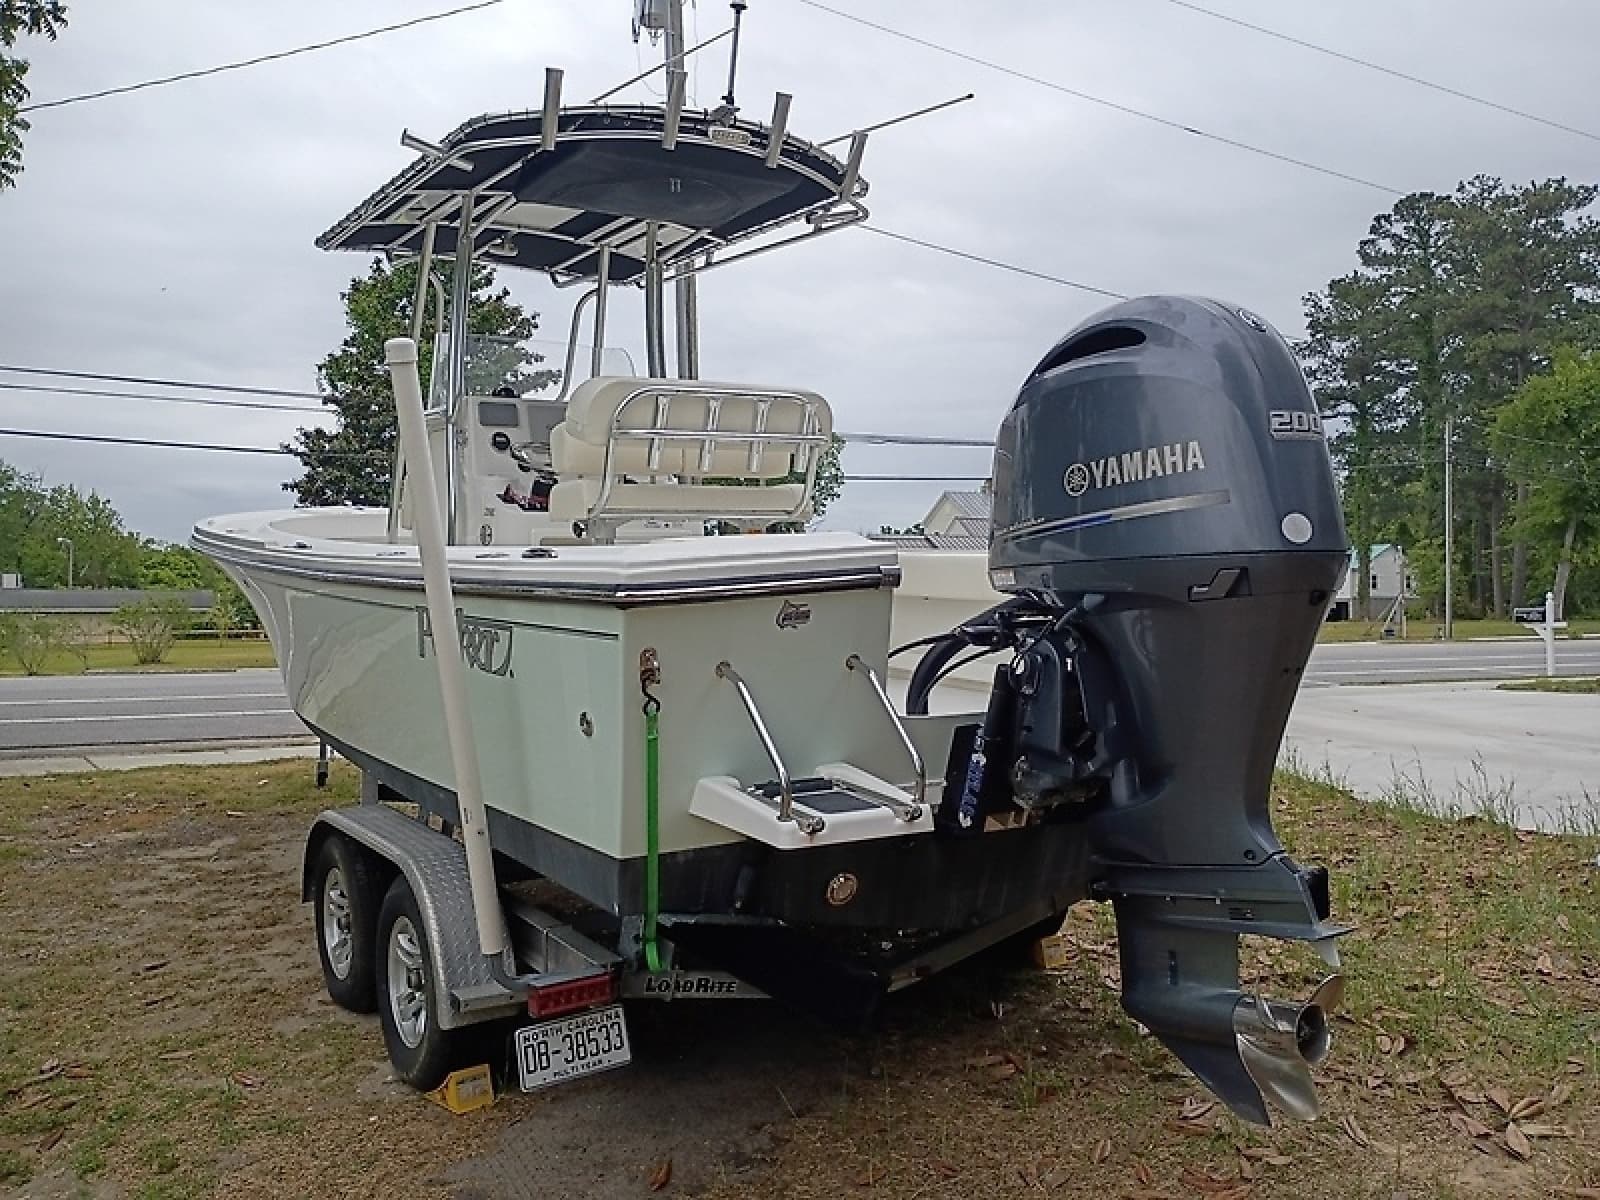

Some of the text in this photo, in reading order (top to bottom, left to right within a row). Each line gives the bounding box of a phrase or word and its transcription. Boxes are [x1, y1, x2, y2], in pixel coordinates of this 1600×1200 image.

[1269, 411, 1322, 433] 200
[1089, 440, 1205, 489] YAMAHA
[523, 1010, 621, 1043] NORTH CAROLINA
